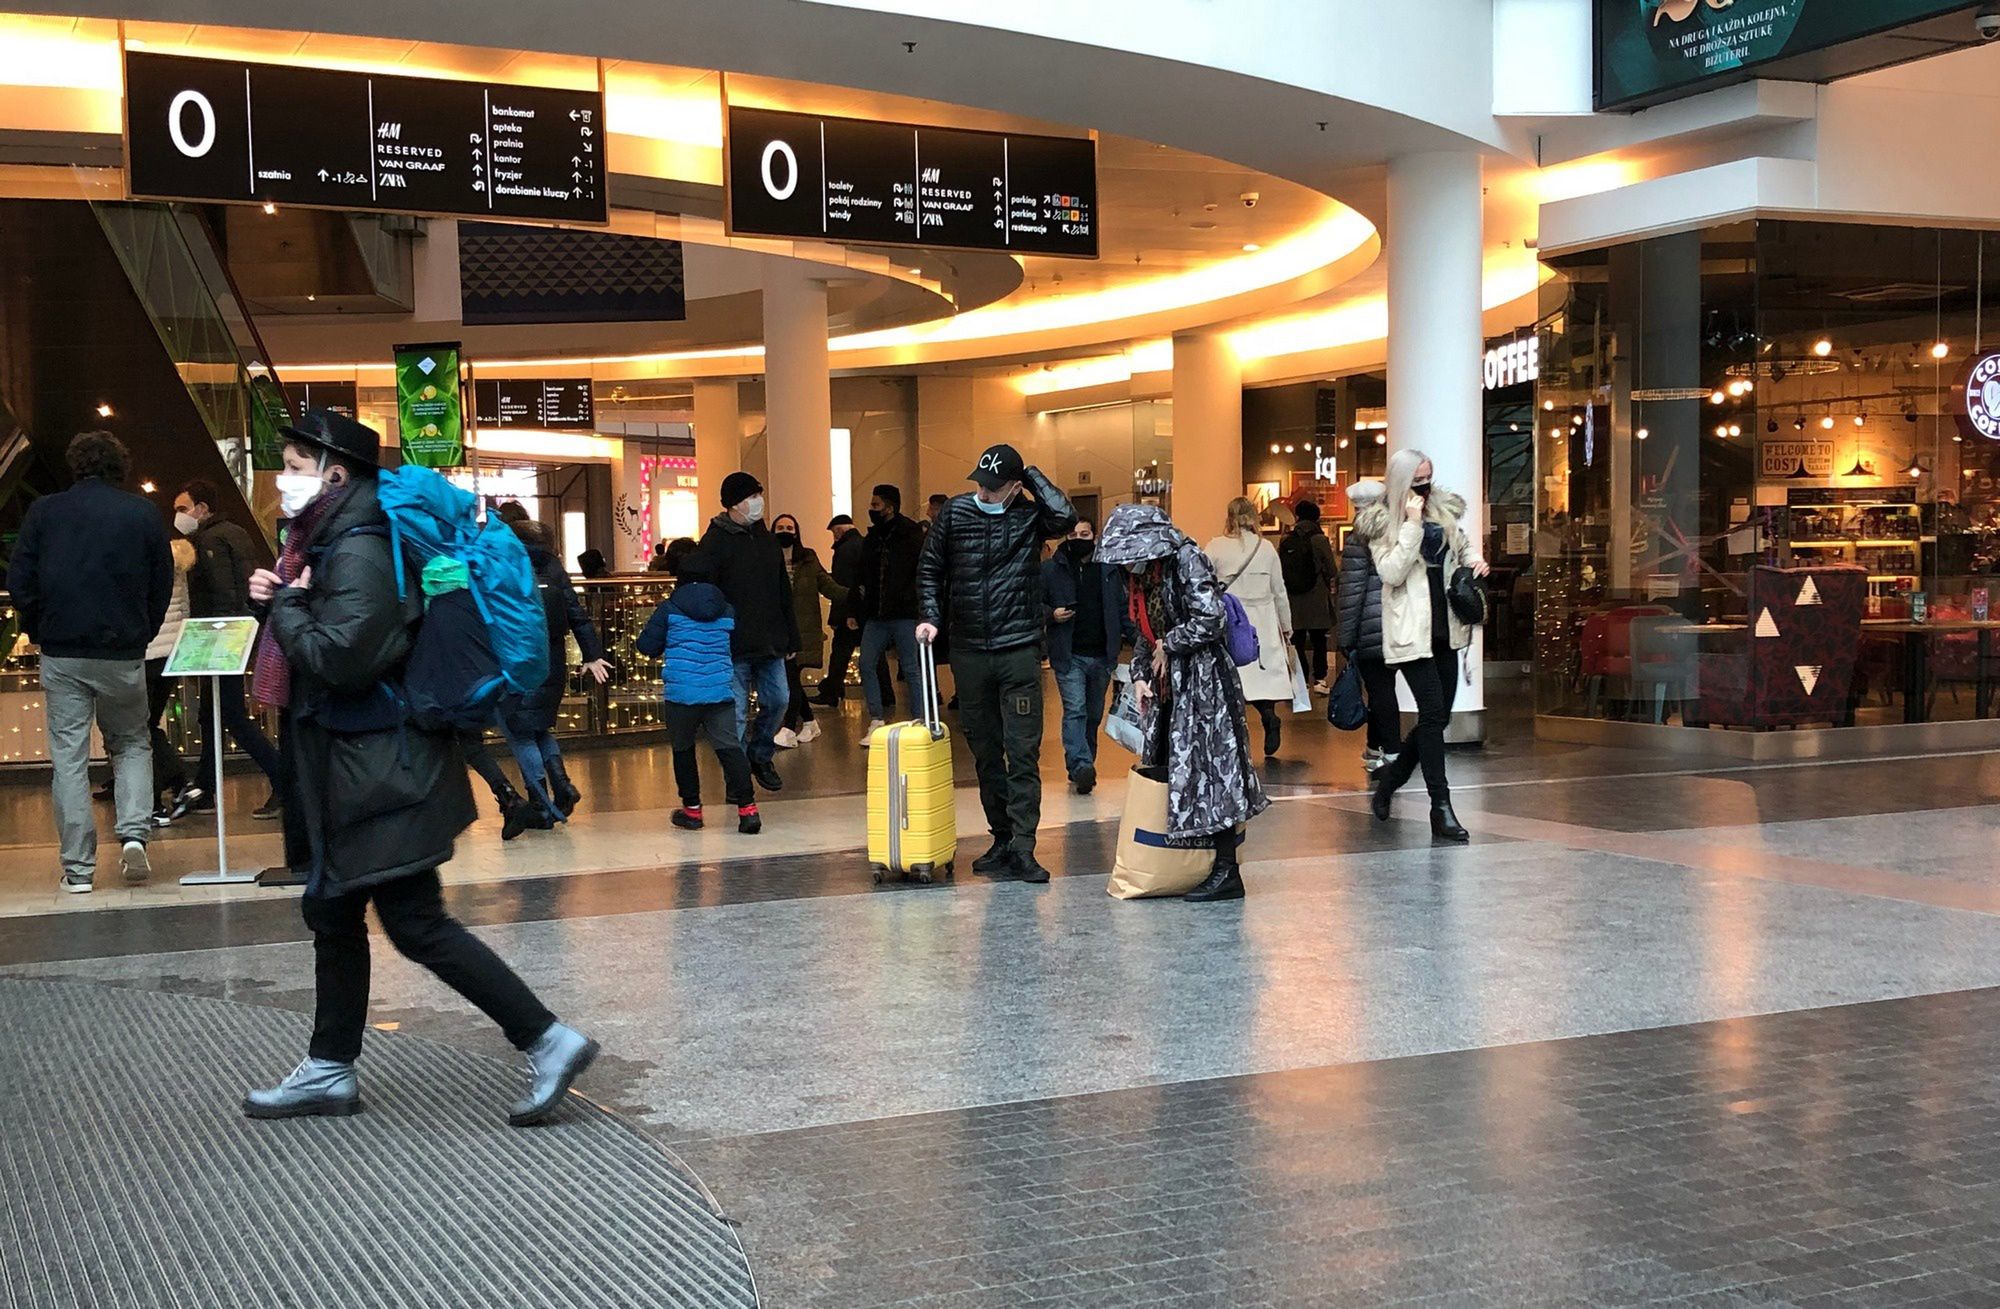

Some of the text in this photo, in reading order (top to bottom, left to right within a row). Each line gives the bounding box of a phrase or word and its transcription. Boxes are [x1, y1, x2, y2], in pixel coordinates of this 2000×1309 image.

[1669, 39, 1679, 48] NA
[1684, 46, 1698, 58] NIE
[492, 105, 535, 118] bankomat
[378, 123, 401, 139] H&M
[493, 122, 522, 133] apteka
[493, 138, 524, 149] pralnia
[378, 145, 442, 157] RESERVED
[494, 153, 522, 164] kantor
[379, 159, 445, 171] VAN GRAAF
[258, 170, 291, 180] szatnia
[380, 173, 406, 187] ZARA
[495, 168, 522, 181] fryzjer
[922, 168, 940, 183] H&M
[495, 184, 541, 197] dorabianie
[829, 181, 853, 192] toalety
[922, 188, 971, 199] RESERVED
[829, 195, 882, 208] pokój rodzinny
[922, 200, 973, 211] VAN GRAAF
[1011, 195, 1036, 206] parking
[829, 210, 851, 222] windy
[1011, 209, 1036, 220] parking
[1012, 224, 1047, 234] restauracje
[1481, 336, 1539, 390] OFFEE
[1765, 444, 1831, 456] WELCOME TO
[1765, 457, 1799, 471] COST
[1164, 836, 1191, 847] VAN
